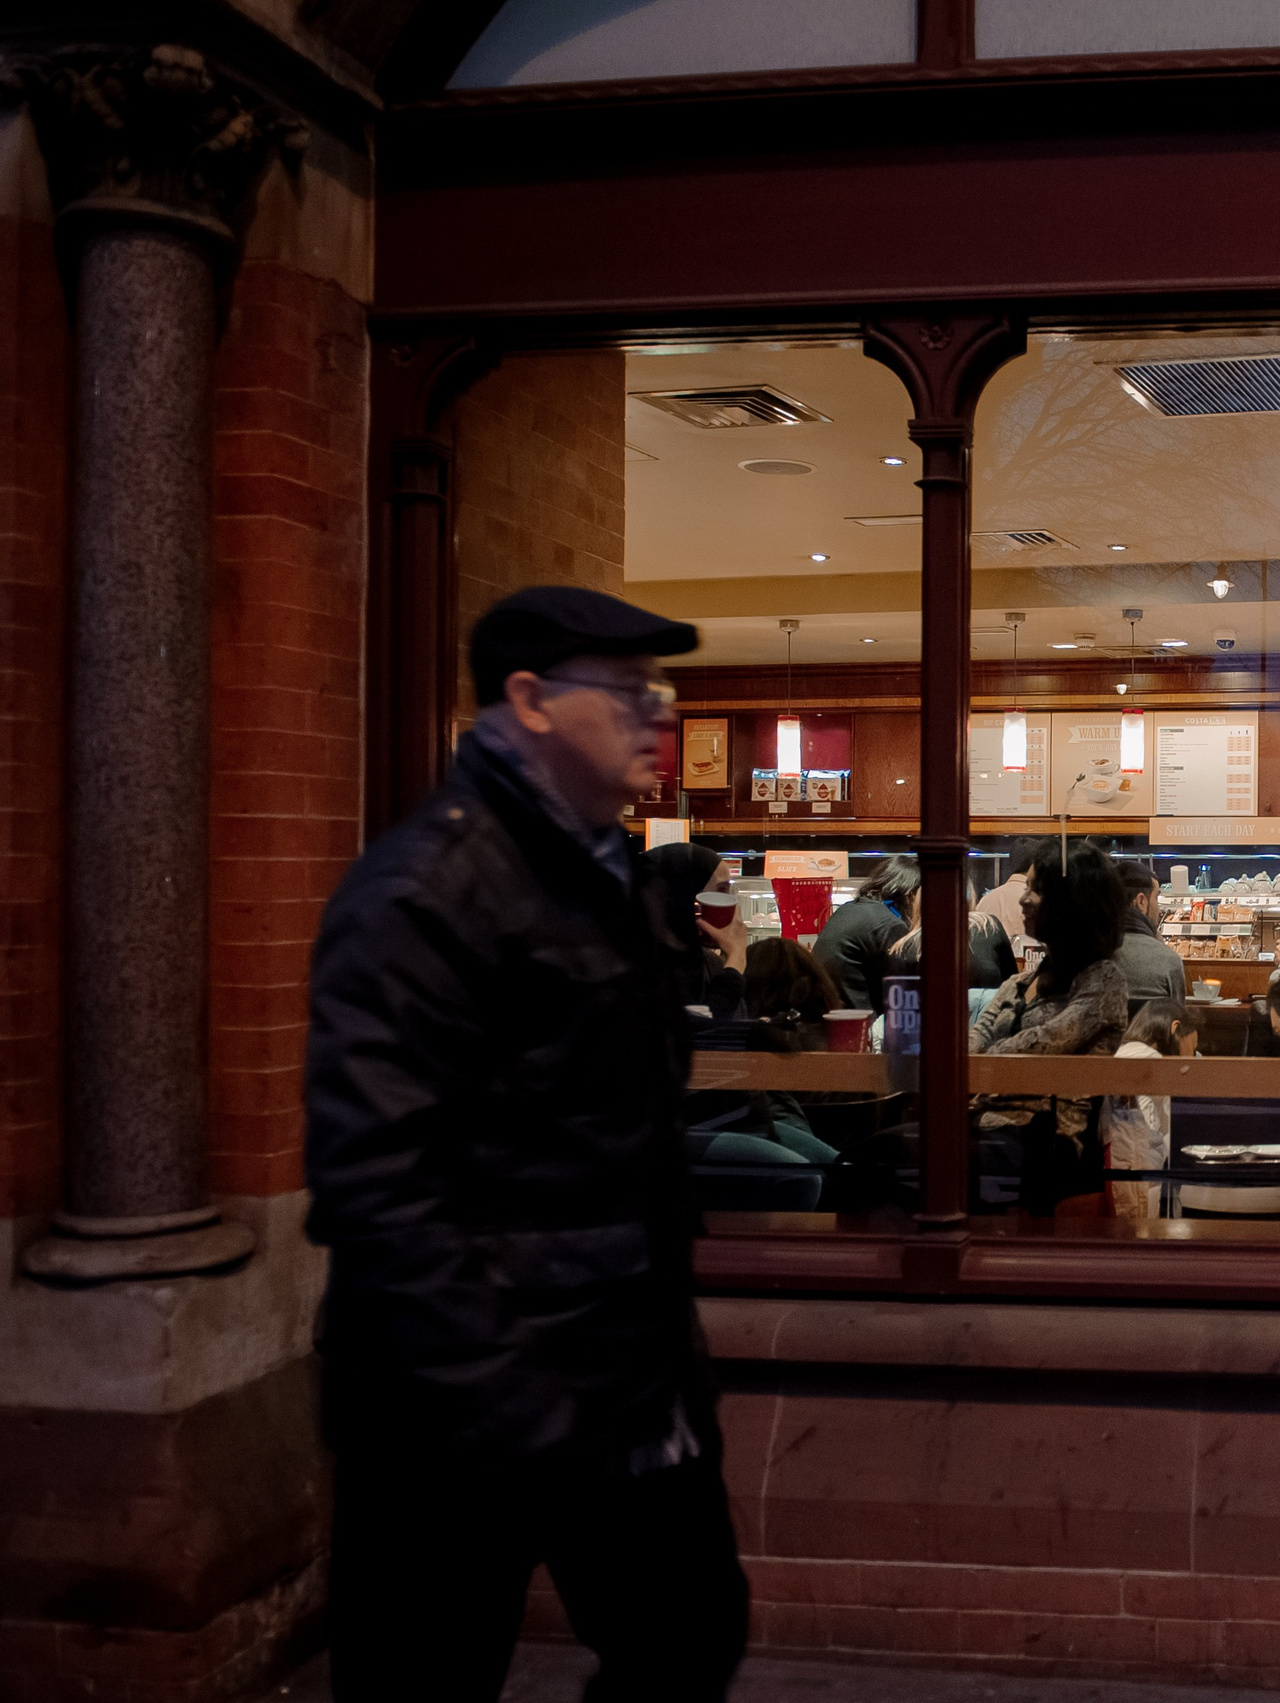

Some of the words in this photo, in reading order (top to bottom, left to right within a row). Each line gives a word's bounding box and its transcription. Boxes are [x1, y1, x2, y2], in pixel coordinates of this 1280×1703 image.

[1185, 717, 1209, 725] COSTA
[1078, 727, 1110, 739] WARM
[1166, 824, 1201, 837] START
[1204, 824, 1232, 837] EACH
[1235, 824, 1256, 837] DAY
[776, 865, 798, 873] SLICE
